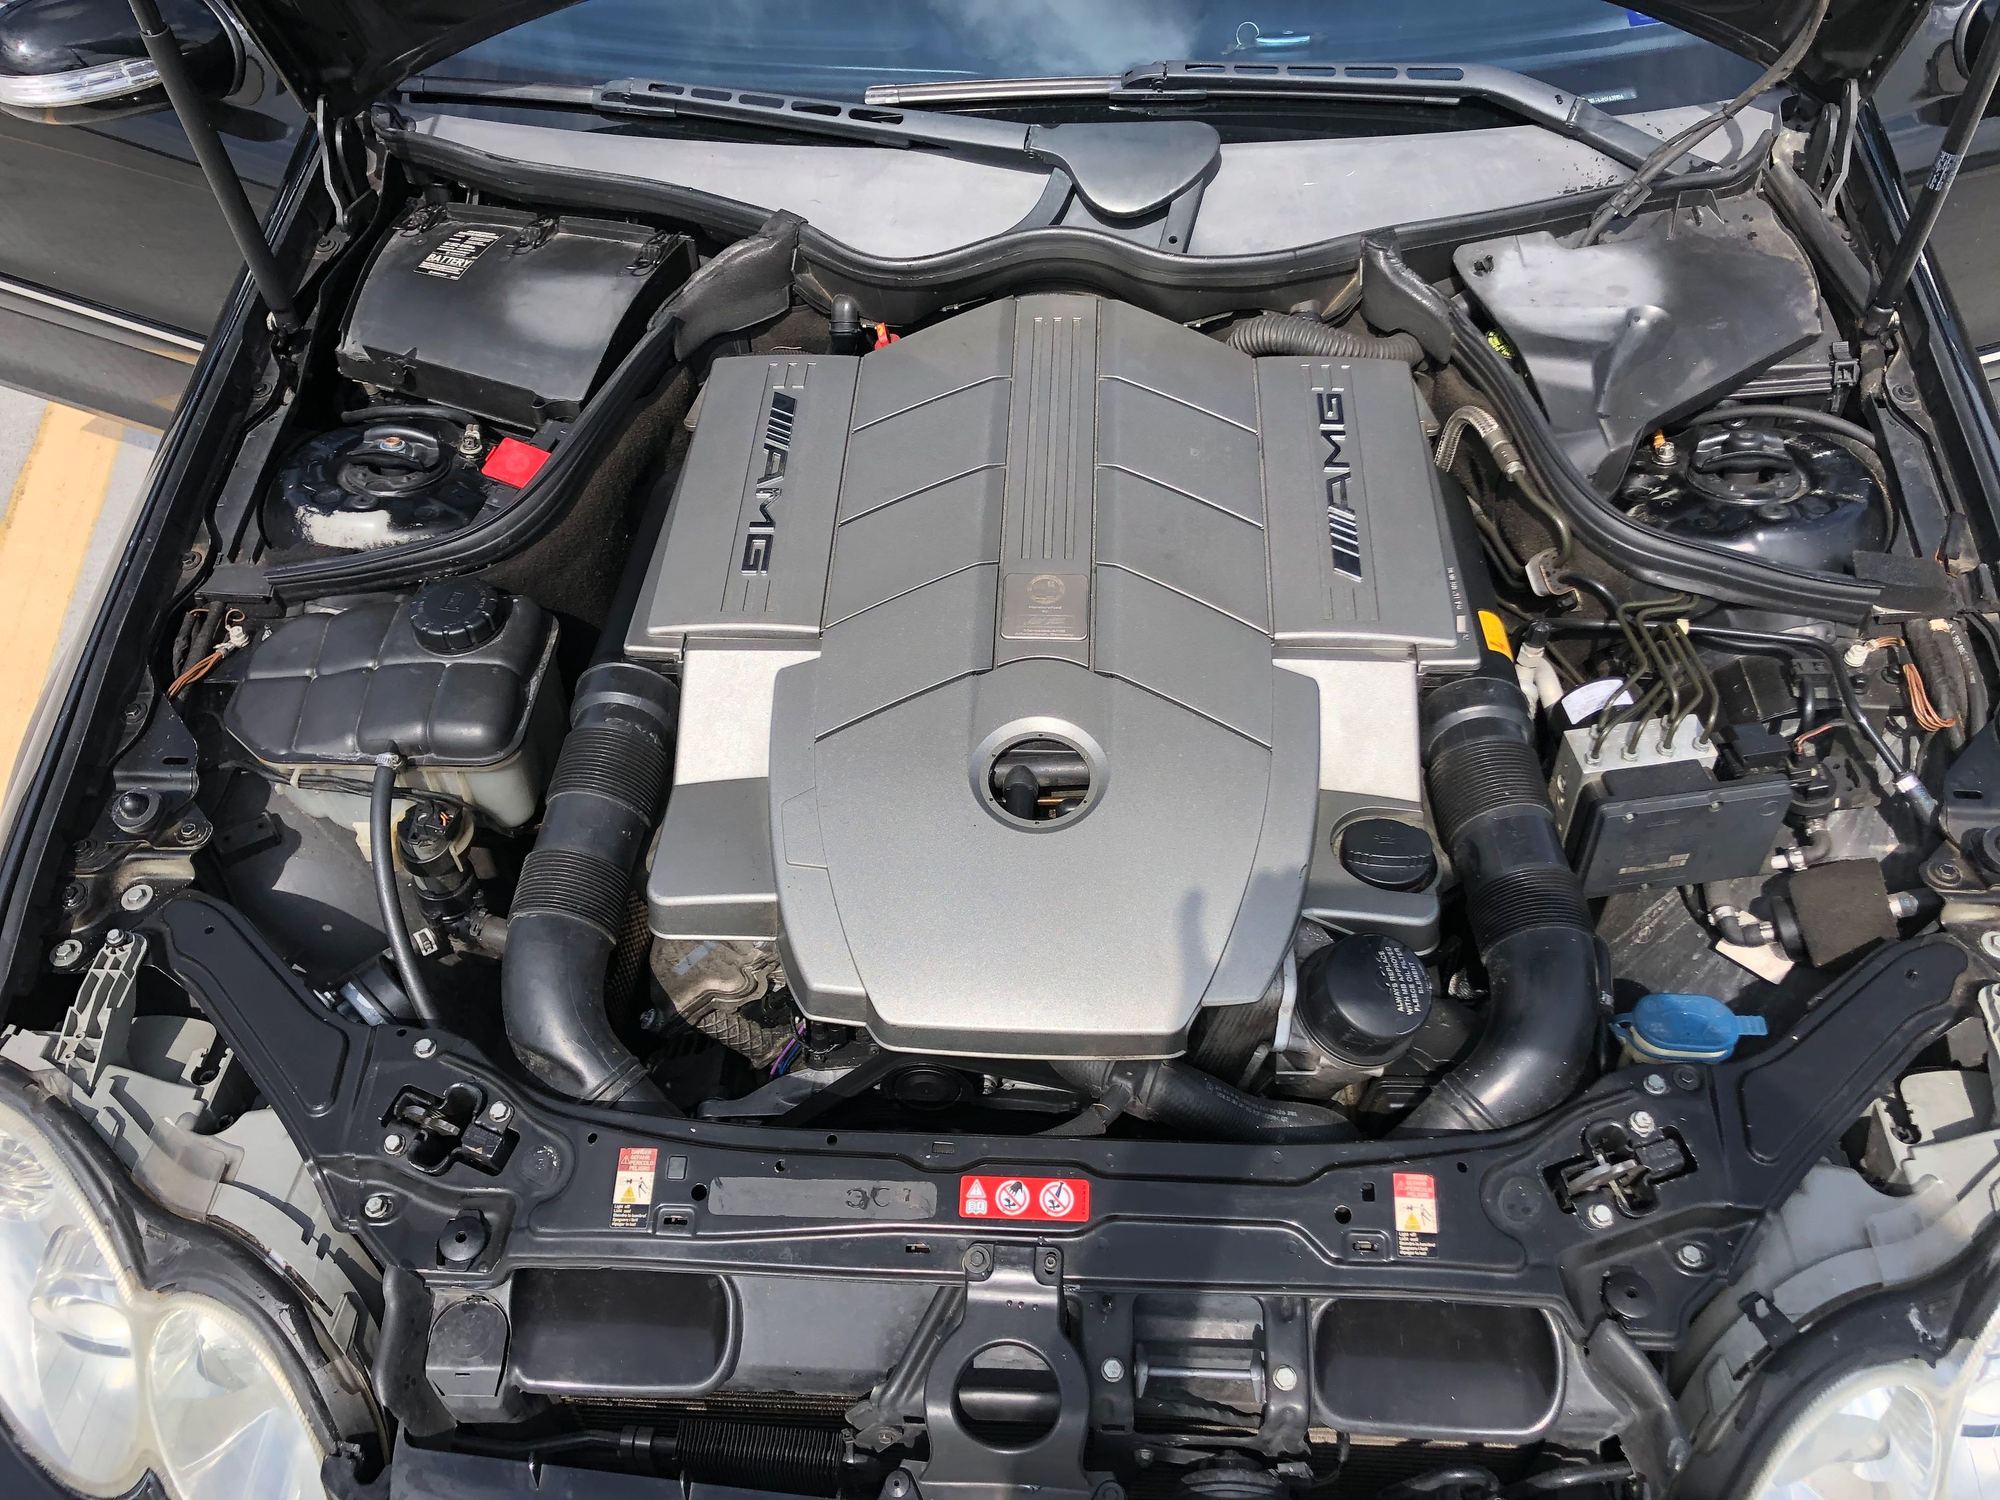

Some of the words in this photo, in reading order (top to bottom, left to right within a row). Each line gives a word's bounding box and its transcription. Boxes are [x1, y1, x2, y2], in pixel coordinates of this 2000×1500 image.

[425, 253, 474, 268] BATTERY
[1316, 393, 1357, 522] AMG
[741, 437, 790, 575] AMG
[1378, 950, 1396, 982] REPLACE
[1384, 946, 1405, 982] APPROVED
[1393, 947, 1408, 969] FILTER
[1405, 971, 1413, 983] OIL
[1407, 962, 1425, 995] ELEMENT
[1391, 982, 1405, 1013] ALWAYS
[1403, 996, 1414, 1016] WITH
